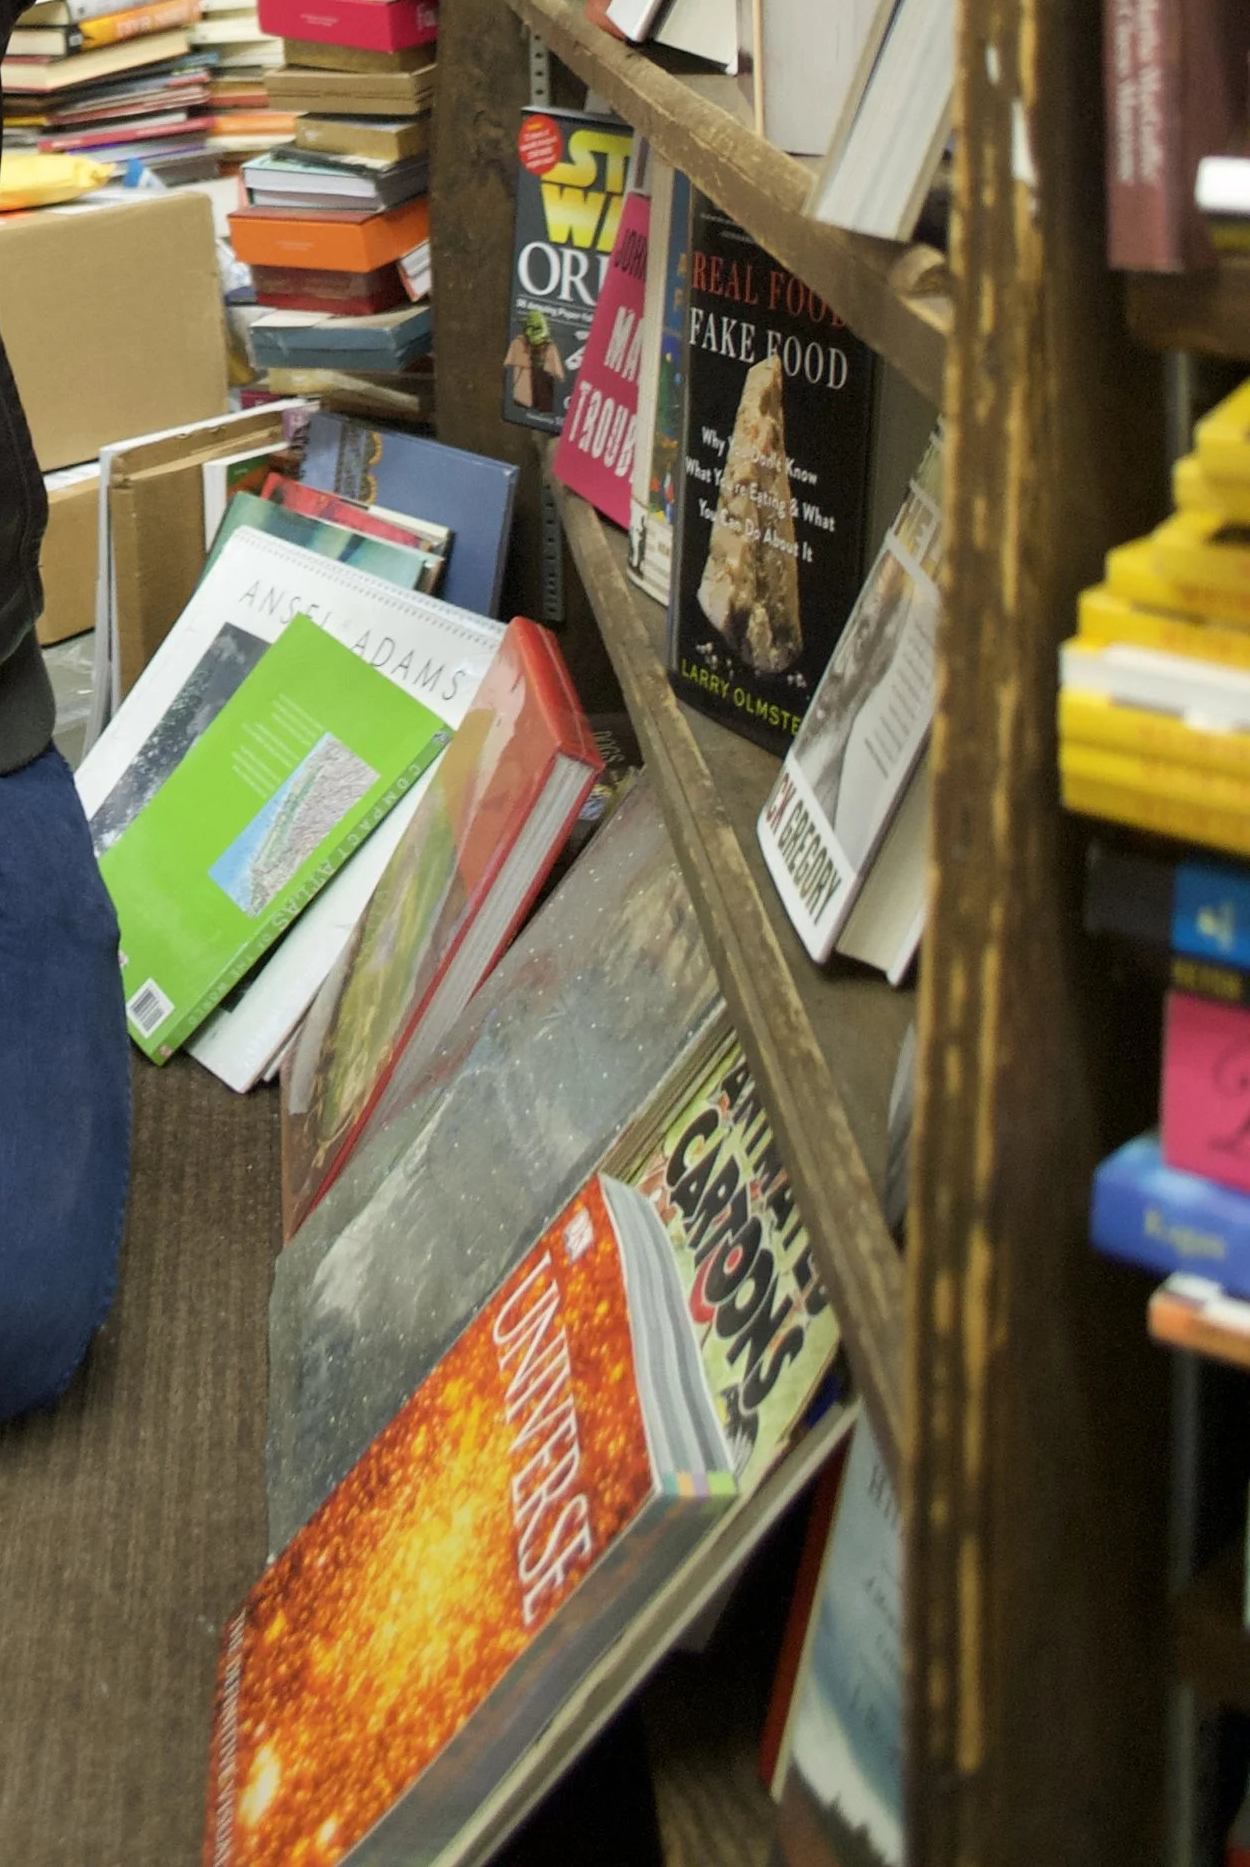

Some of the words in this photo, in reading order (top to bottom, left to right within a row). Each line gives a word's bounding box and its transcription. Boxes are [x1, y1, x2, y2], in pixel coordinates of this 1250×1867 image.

[692, 250, 759, 307] REAL
[767, 269, 847, 331] FOO
[688, 306, 756, 365] FAKE
[766, 329, 848, 391] FOOD
[567, 380, 637, 485] TROUB
[701, 425, 726, 458] Why
[785, 455, 818, 486] Know
[684, 454, 712, 485] What
[749, 481, 786, 520] Eating
[789, 496, 800, 519] &
[801, 501, 836, 533] What
[699, 497, 717, 523] You
[720, 508, 742, 533] Can
[745, 516, 762, 541] Do
[763, 527, 800, 558] About
[802, 540, 814, 563] It
[349, 630, 468, 701] ADAMS
[681, 656, 731, 701] LARRY
[334, 760, 425, 864] COMPACT
[272, 858, 338, 934] ATLAS
[776, 804, 842, 926] GREGORY
[664, 1107, 806, 1412] CARTOONS
[492, 1249, 593, 1629] UNIVERSE
